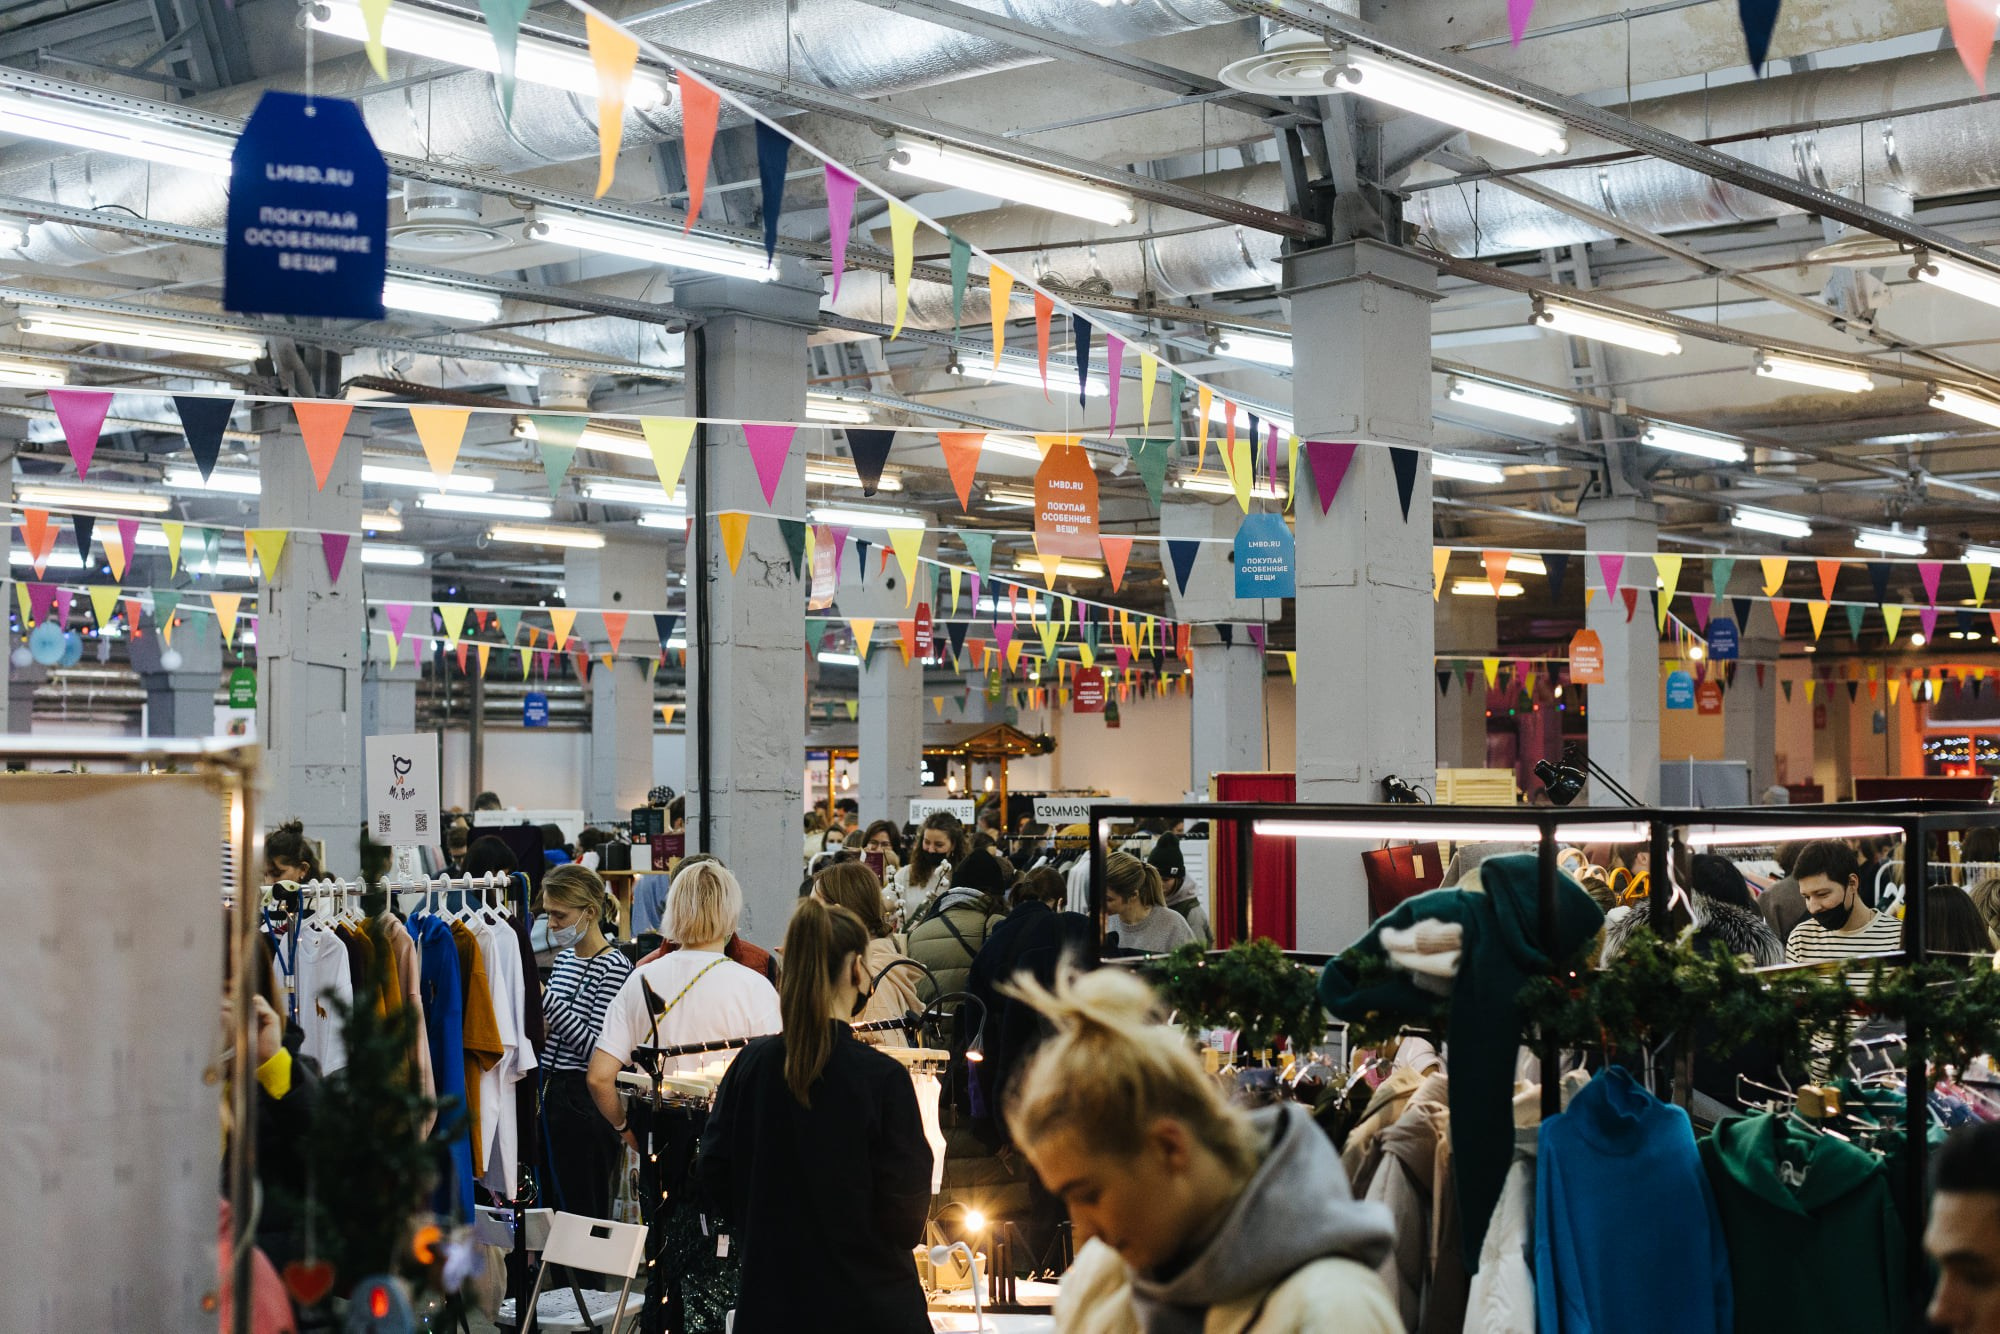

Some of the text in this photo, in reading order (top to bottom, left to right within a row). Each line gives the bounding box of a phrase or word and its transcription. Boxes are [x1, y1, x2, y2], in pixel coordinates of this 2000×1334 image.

[266, 163, 354, 187] LMBD.RU
[259, 206, 358, 230] ПОКУПАЙ
[244, 227, 370, 253] ОСОБЕННЫЕ
[279, 252, 337, 273] ВЕЩИ
[1049, 480, 1083, 490] LMBD.RU
[1047, 501, 1086, 512] ПОКУПАЙ
[1041, 512, 1091, 524] ОСОБЕННЫЕ
[1056, 524, 1079, 535] ВЕЩИ
[960, 806, 973, 817] SET
[1036, 805, 1090, 817] COMMON
